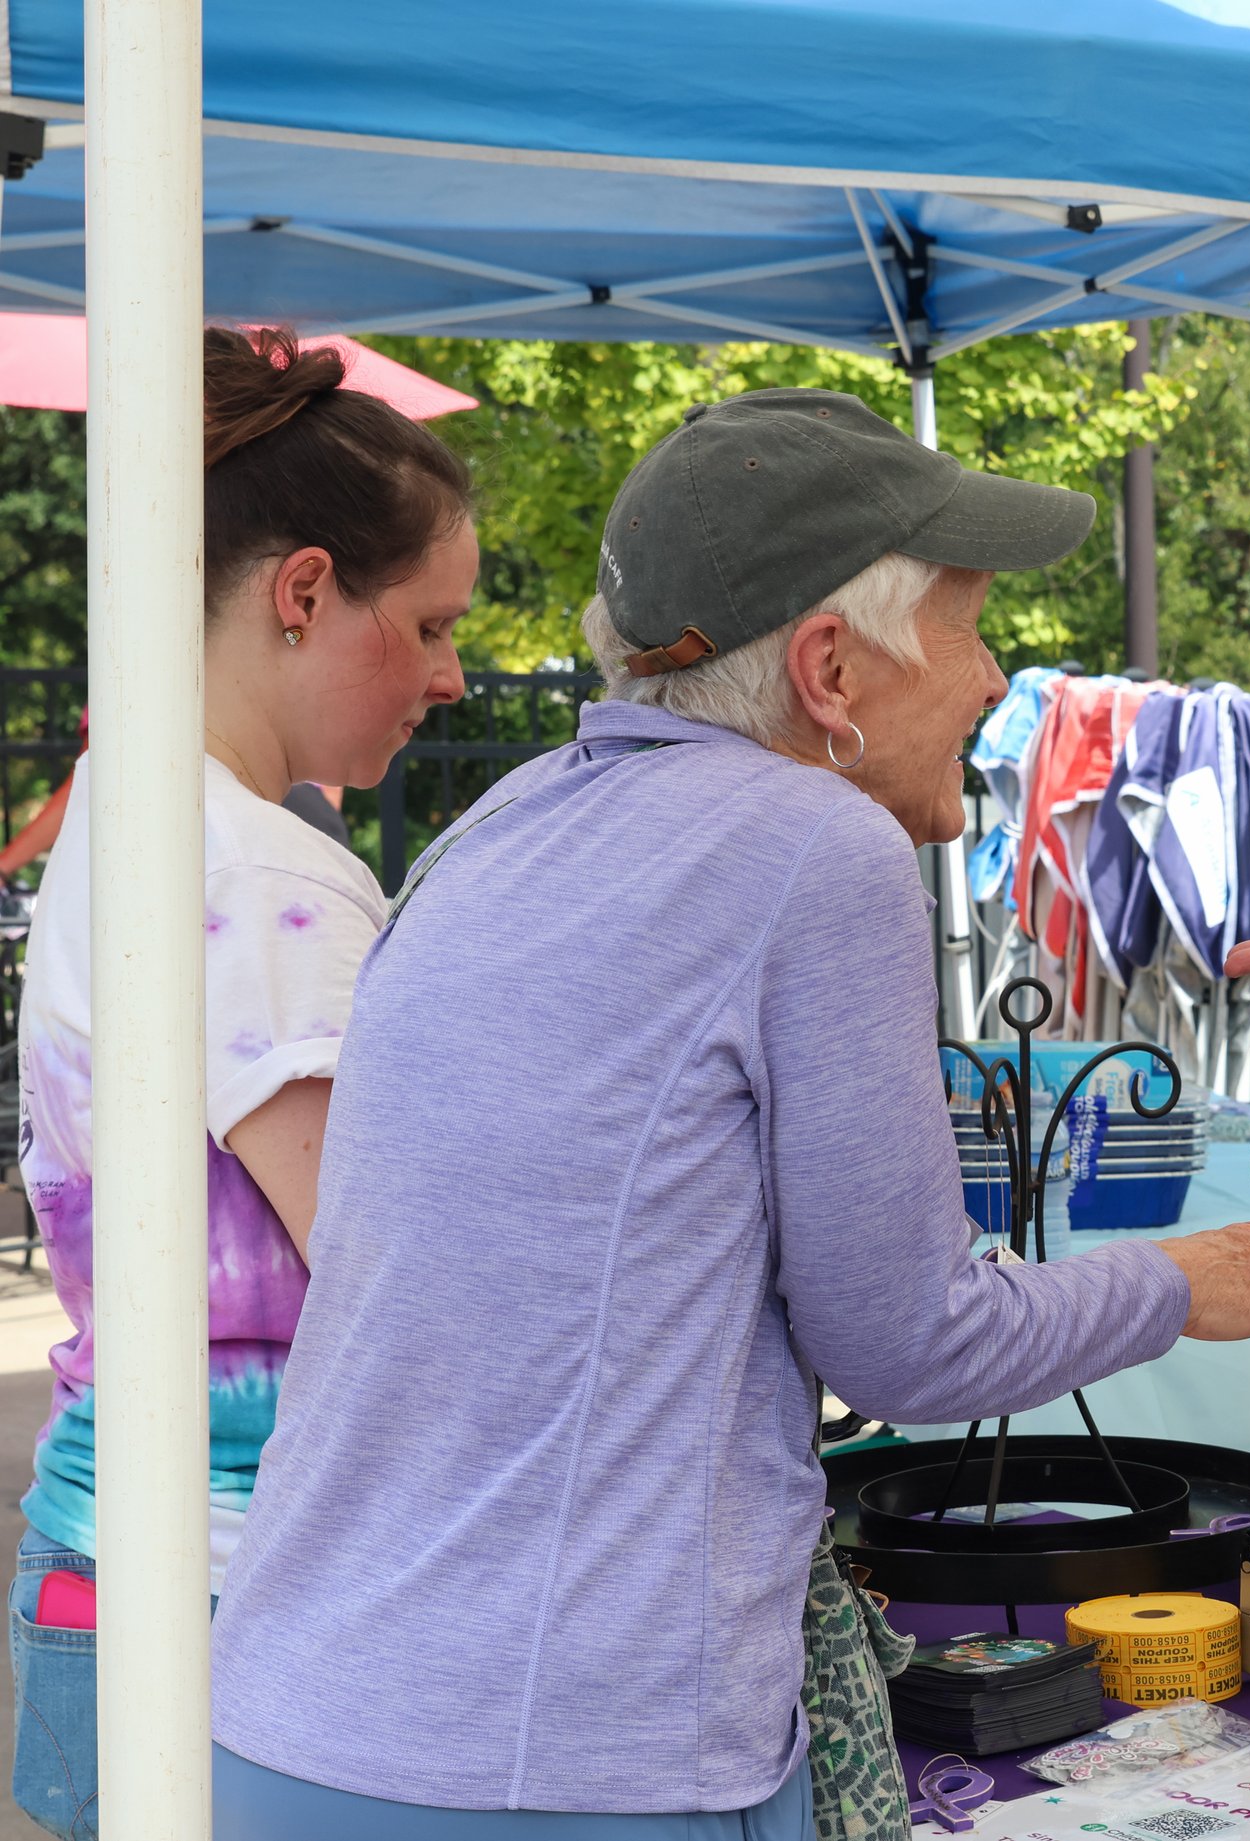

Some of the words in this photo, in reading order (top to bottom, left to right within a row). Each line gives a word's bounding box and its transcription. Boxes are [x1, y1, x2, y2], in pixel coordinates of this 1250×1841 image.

[1133, 1635, 1190, 1647] 60458-008
[1137, 1647, 1189, 1657] COUPON
[1206, 1649, 1226, 1659] THIS
[1132, 1656, 1162, 1665] THIS
[1163, 1654, 1195, 1664] KEEP
[1135, 1673, 1191, 1685] 60458-008
[1208, 1672, 1240, 1695] TICKET
[1134, 1686, 1196, 1701] TICKET
[1160, 1787, 1230, 1810] OOR
